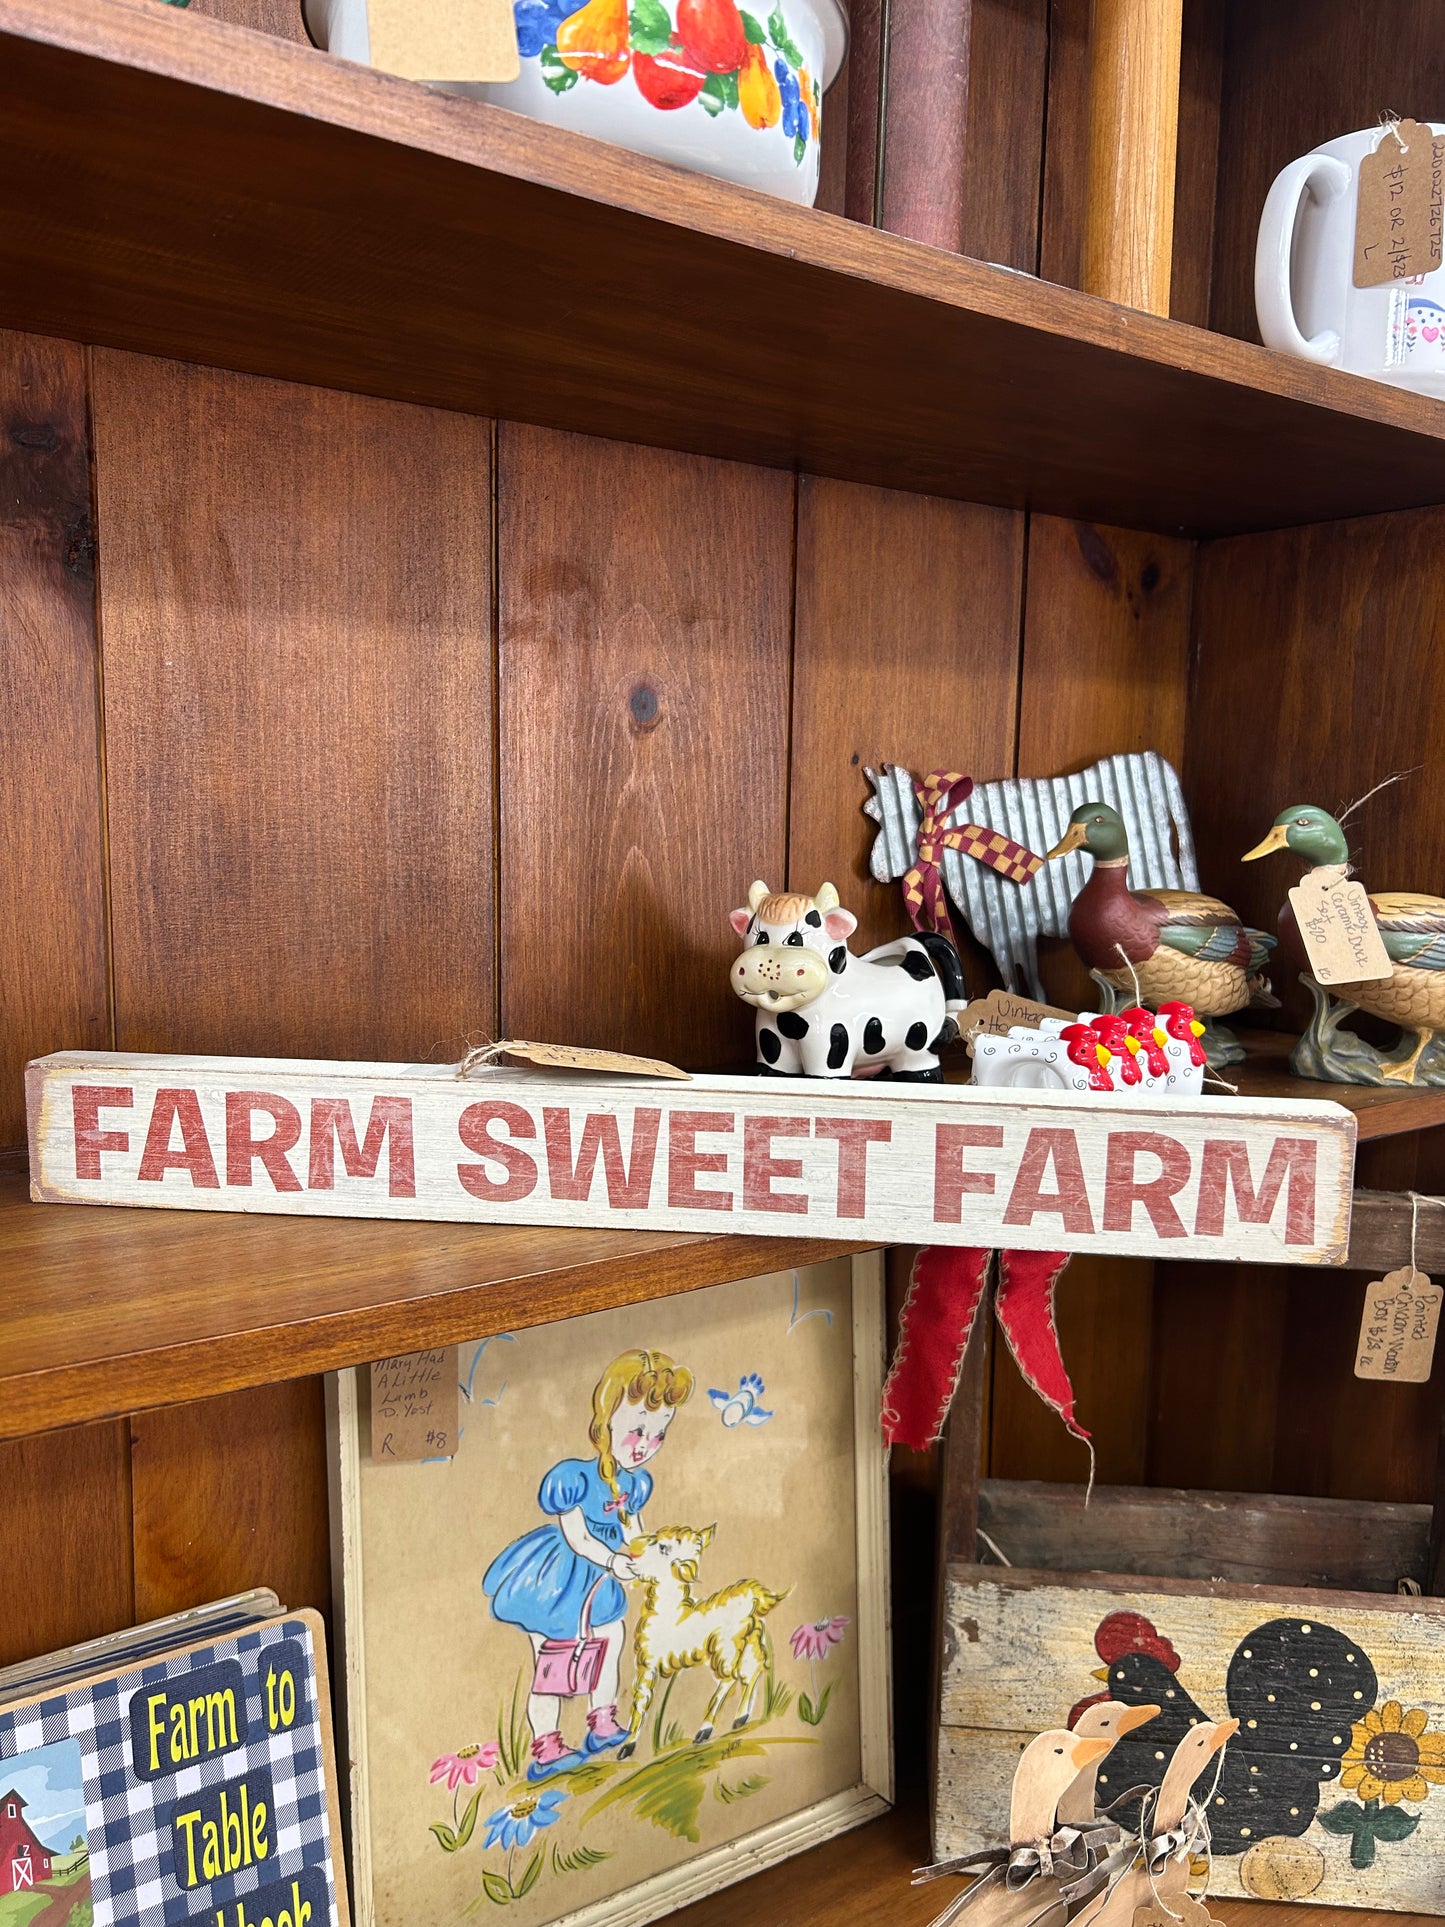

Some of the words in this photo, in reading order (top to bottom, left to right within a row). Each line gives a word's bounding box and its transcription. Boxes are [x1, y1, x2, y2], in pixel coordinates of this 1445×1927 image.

[1383, 164, 1409, 201] $12
[1390, 207, 1405, 231] OR
[1316, 900, 1335, 924] Set
[1347, 889, 1368, 934] Vintage
[1305, 917, 1327, 944] $20
[1331, 892, 1356, 935] Ceramic
[1348, 936, 1368, 968] Duck
[72, 1085, 416, 1199] FARM
[457, 1101, 892, 1219] SWEET
[933, 1123, 1318, 1246] FARM
[1374, 1298, 1396, 1322] Box
[374, 1359, 411, 1373] Mary
[417, 1349, 445, 1366] Had
[378, 1374, 388, 1388] A
[392, 1367, 441, 1388] Little
[382, 1388, 428, 1404] Lamb
[382, 1433, 395, 1456] R
[147, 1687, 239, 1771] Farm
[266, 1662, 296, 1732] to
[176, 1784, 269, 1887] Table
